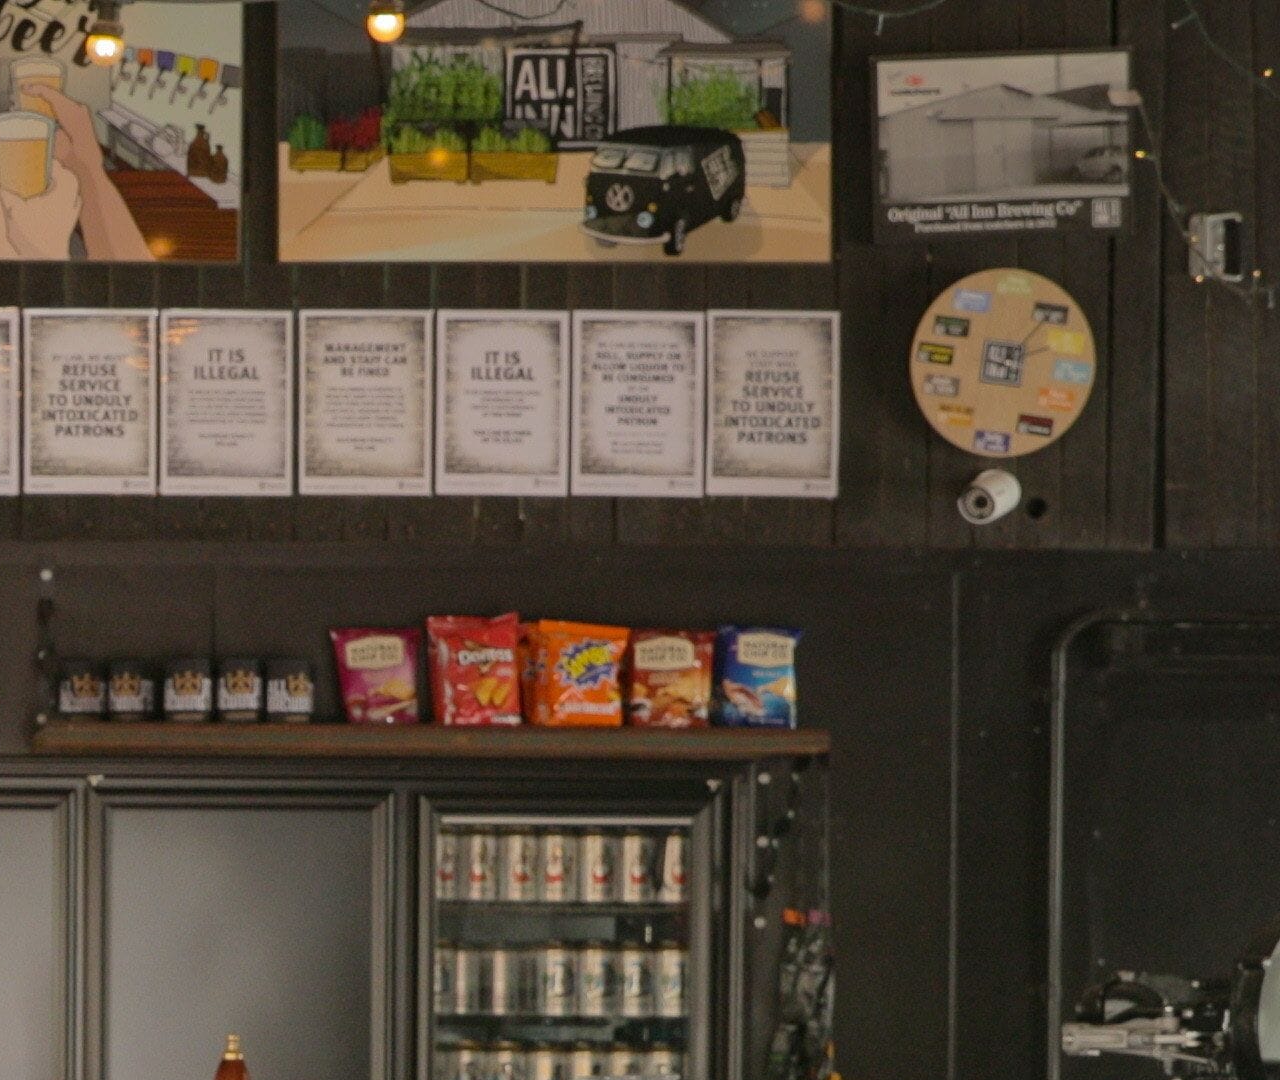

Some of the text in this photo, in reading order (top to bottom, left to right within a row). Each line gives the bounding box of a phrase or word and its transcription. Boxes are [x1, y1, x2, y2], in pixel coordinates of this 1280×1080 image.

[207, 349, 245, 363] IT IS
[484, 350, 521, 365] IT IS
[62, 364, 117, 376] REFUSE
[193, 366, 260, 381] ILLEGAL
[471, 367, 534, 381] ILLEGAL
[744, 370, 800, 384] REFUSE
[58, 379, 122, 391] SERVICE
[742, 386, 804, 399] SERVICE
[48, 394, 132, 407] TO UNDULY
[731, 401, 817, 414] TO UNDULY
[42, 409, 138, 422] INTOXICATED
[724, 416, 821, 429] INTOXICATED
[55, 425, 125, 438] PATRONS
[736, 432, 808, 445] PATRONS
